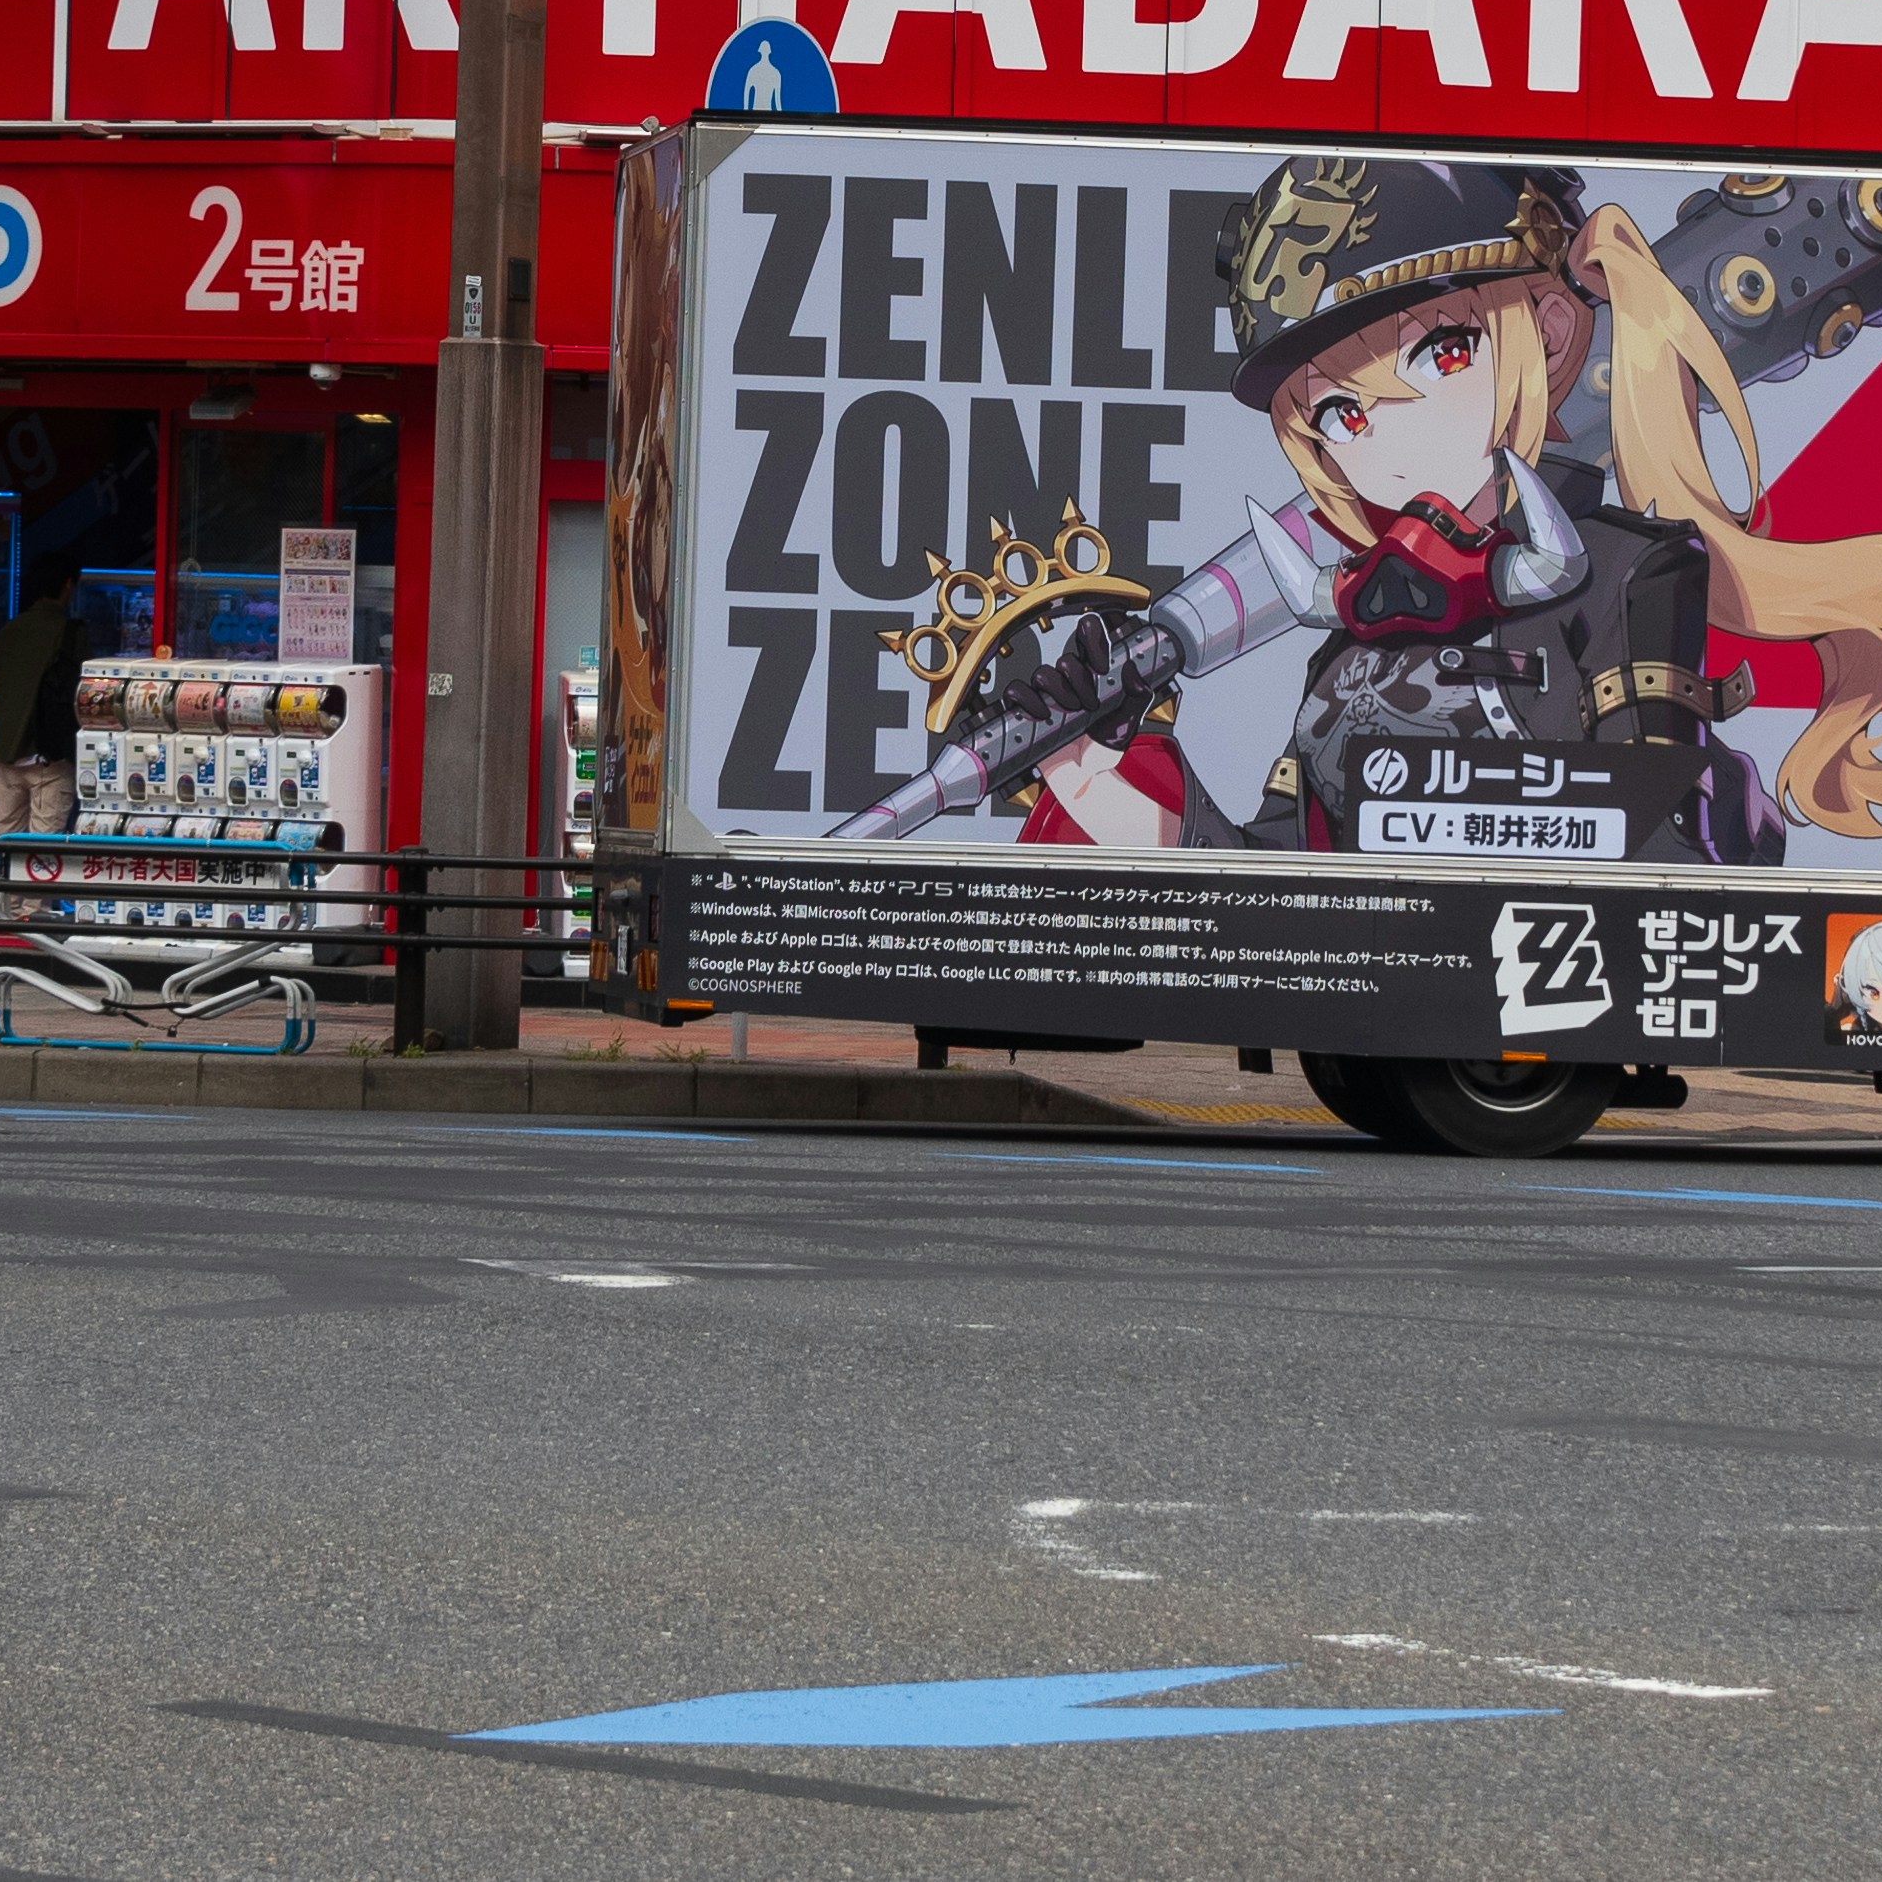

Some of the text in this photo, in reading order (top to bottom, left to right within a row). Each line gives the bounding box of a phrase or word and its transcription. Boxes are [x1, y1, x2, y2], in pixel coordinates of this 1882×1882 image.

[185, 185, 365, 313] 2号館
[724, 389, 1189, 602] ZONE
[1421, 752, 1614, 799] ルーシー
[82, 855, 267, 886] 歩行者天国実施中
[741, 931, 778, 946] および
[781, 932, 817, 948] Apple
[1074, 942, 1110, 959] Apple
[1113, 943, 1137, 958] Inc.
[1638, 910, 1804, 956] ゼンレス
[688, 978, 802, 995] ©COGNOSPHERE
[747, 958, 775, 975] Play
[778, 960, 815, 974] および
[818, 961, 863, 978] Google
[865, 962, 893, 979] Play
[941, 966, 985, 981] Google
[988, 968, 1011, 980] LLC
[1639, 955, 1761, 995] ゾーン
[1636, 1000, 1717, 1039] ゼロ
